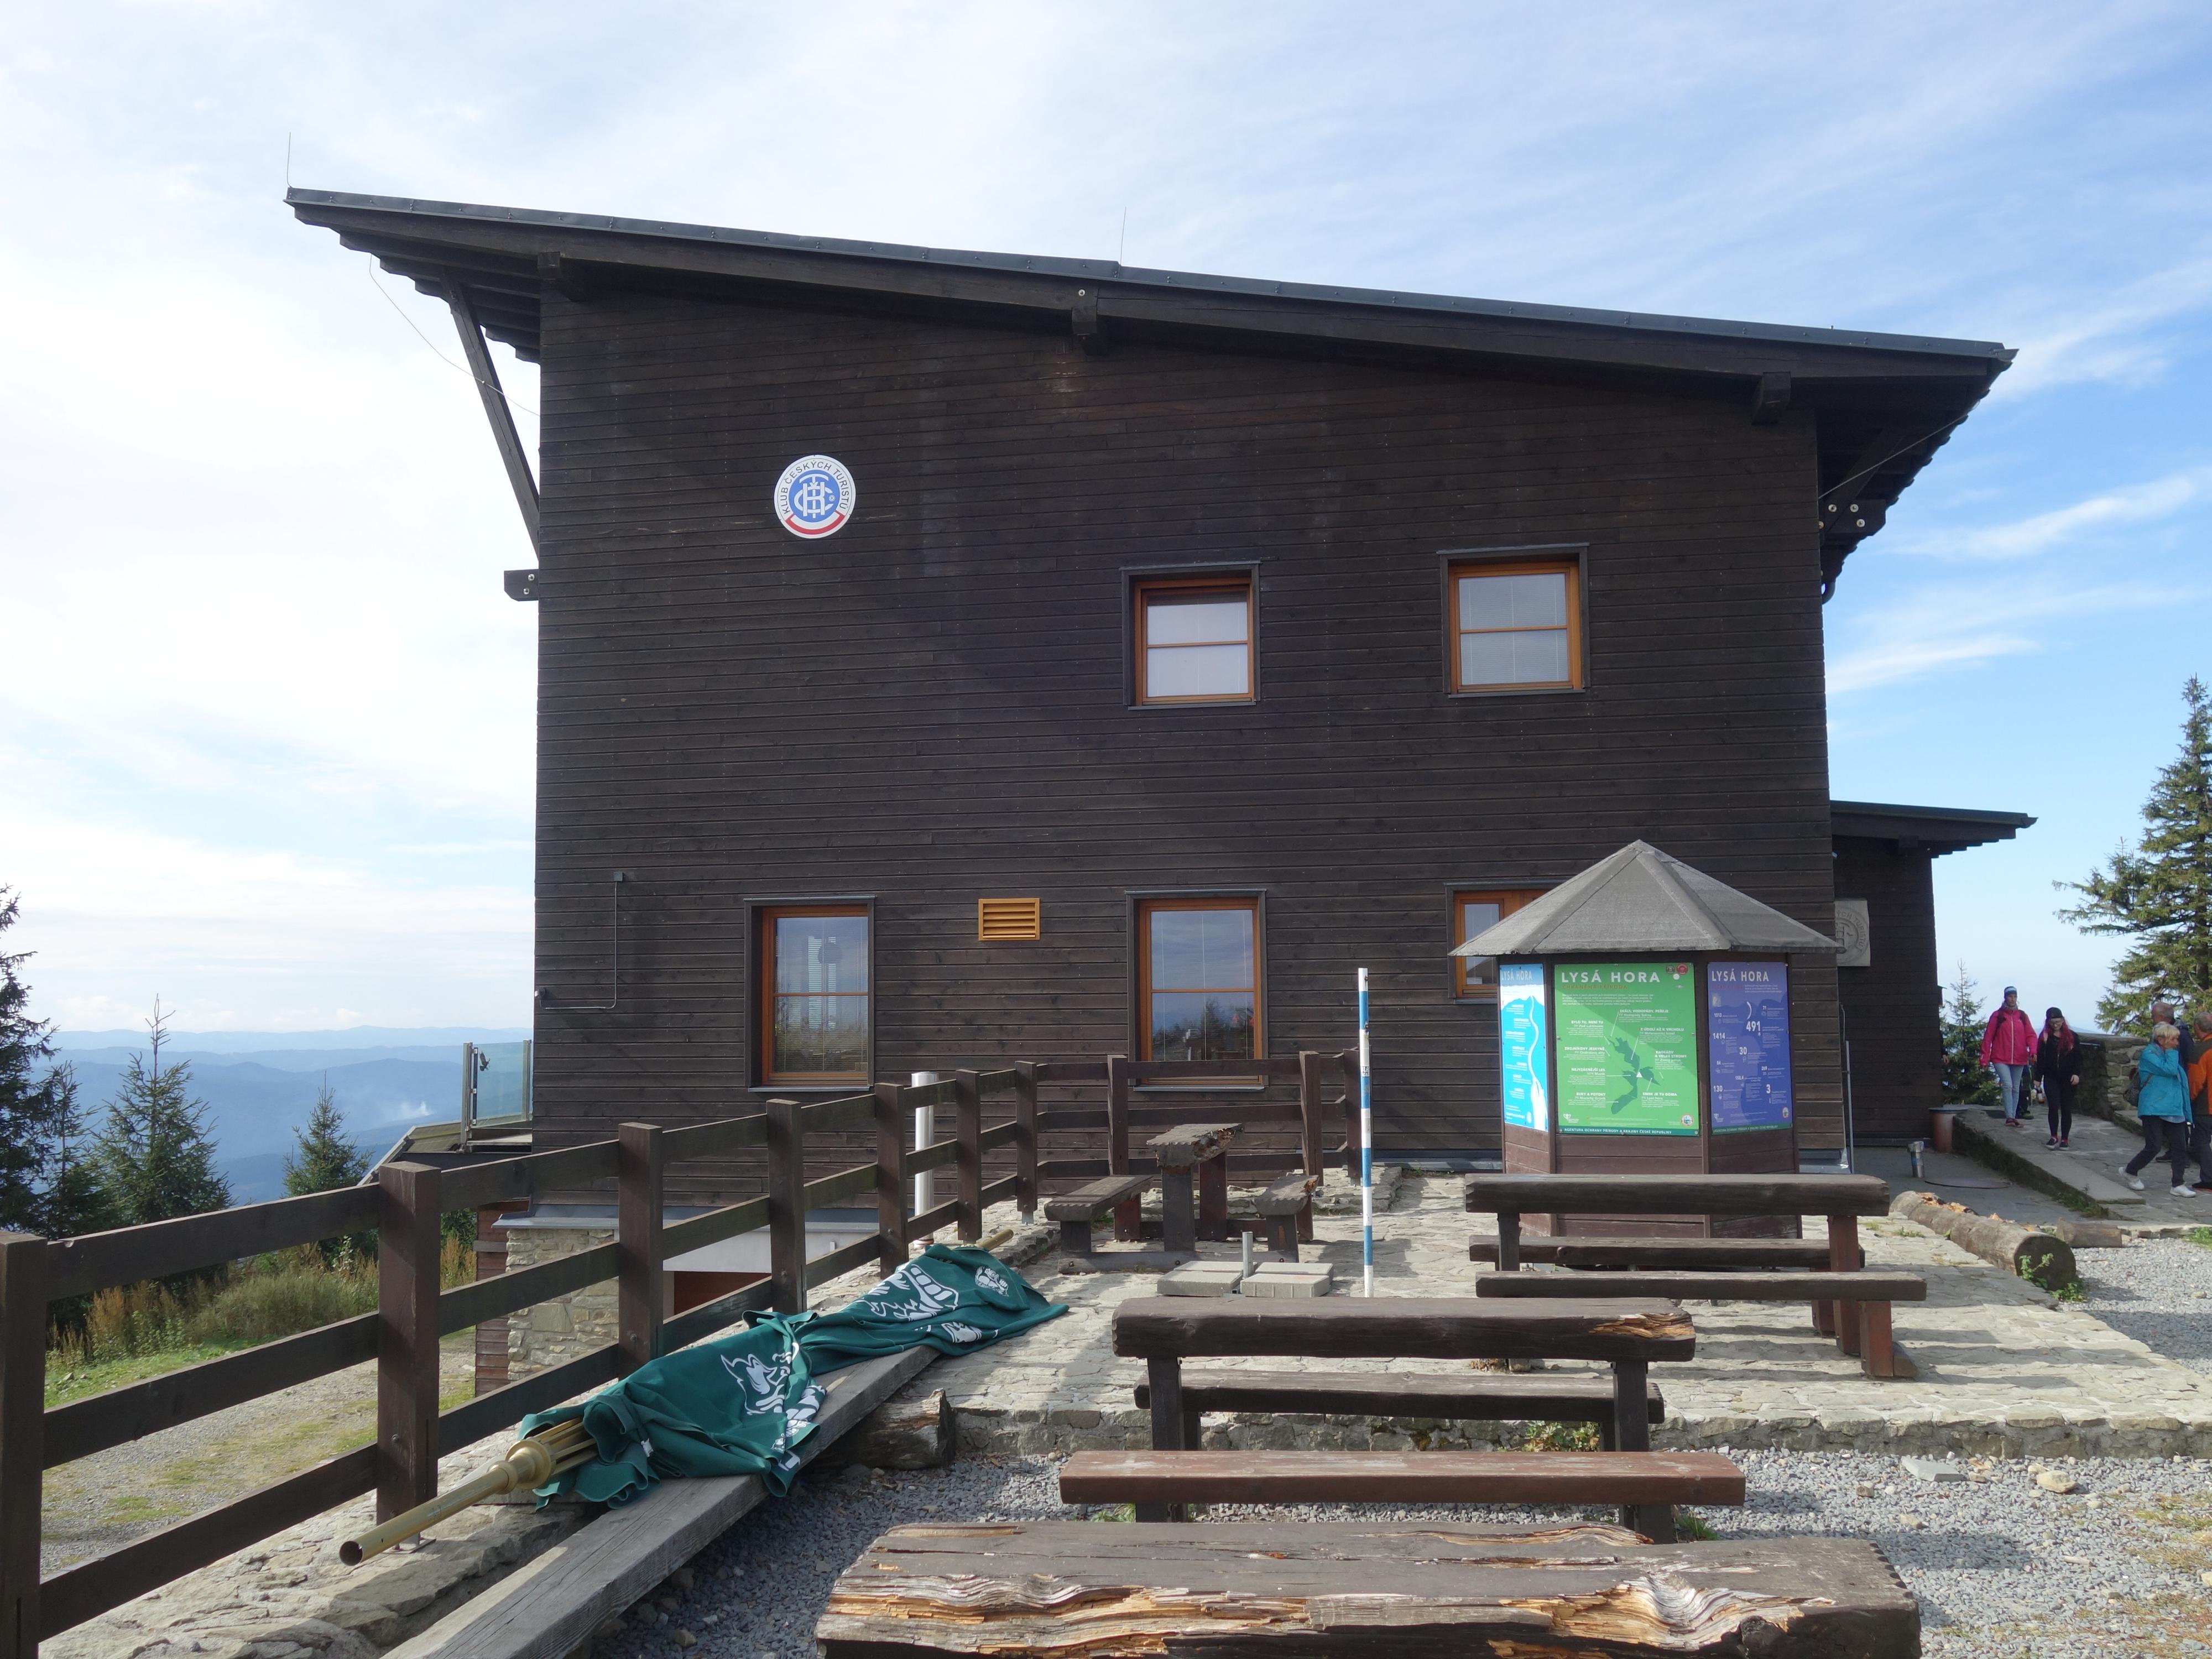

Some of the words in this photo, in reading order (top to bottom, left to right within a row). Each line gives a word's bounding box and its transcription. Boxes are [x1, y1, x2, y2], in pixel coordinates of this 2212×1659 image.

[783, 460, 832, 484] ČESKÝCH
[833, 468, 850, 510] TURISTŮ
[780, 487, 791, 515] KLUB
[1501, 969, 1514, 981] LYSÁ
[1516, 970, 1532, 981] HORA
[1562, 969, 1602, 983] LYSÁ
[1611, 972, 1660, 983] HORA
[1712, 968, 1736, 982] LYSÁ
[1741, 971, 1769, 982] HORA
[1746, 1021, 1761, 1032] 491
[1739, 1046, 1747, 1055] 30
[1766, 1084, 1771, 1094] 3
